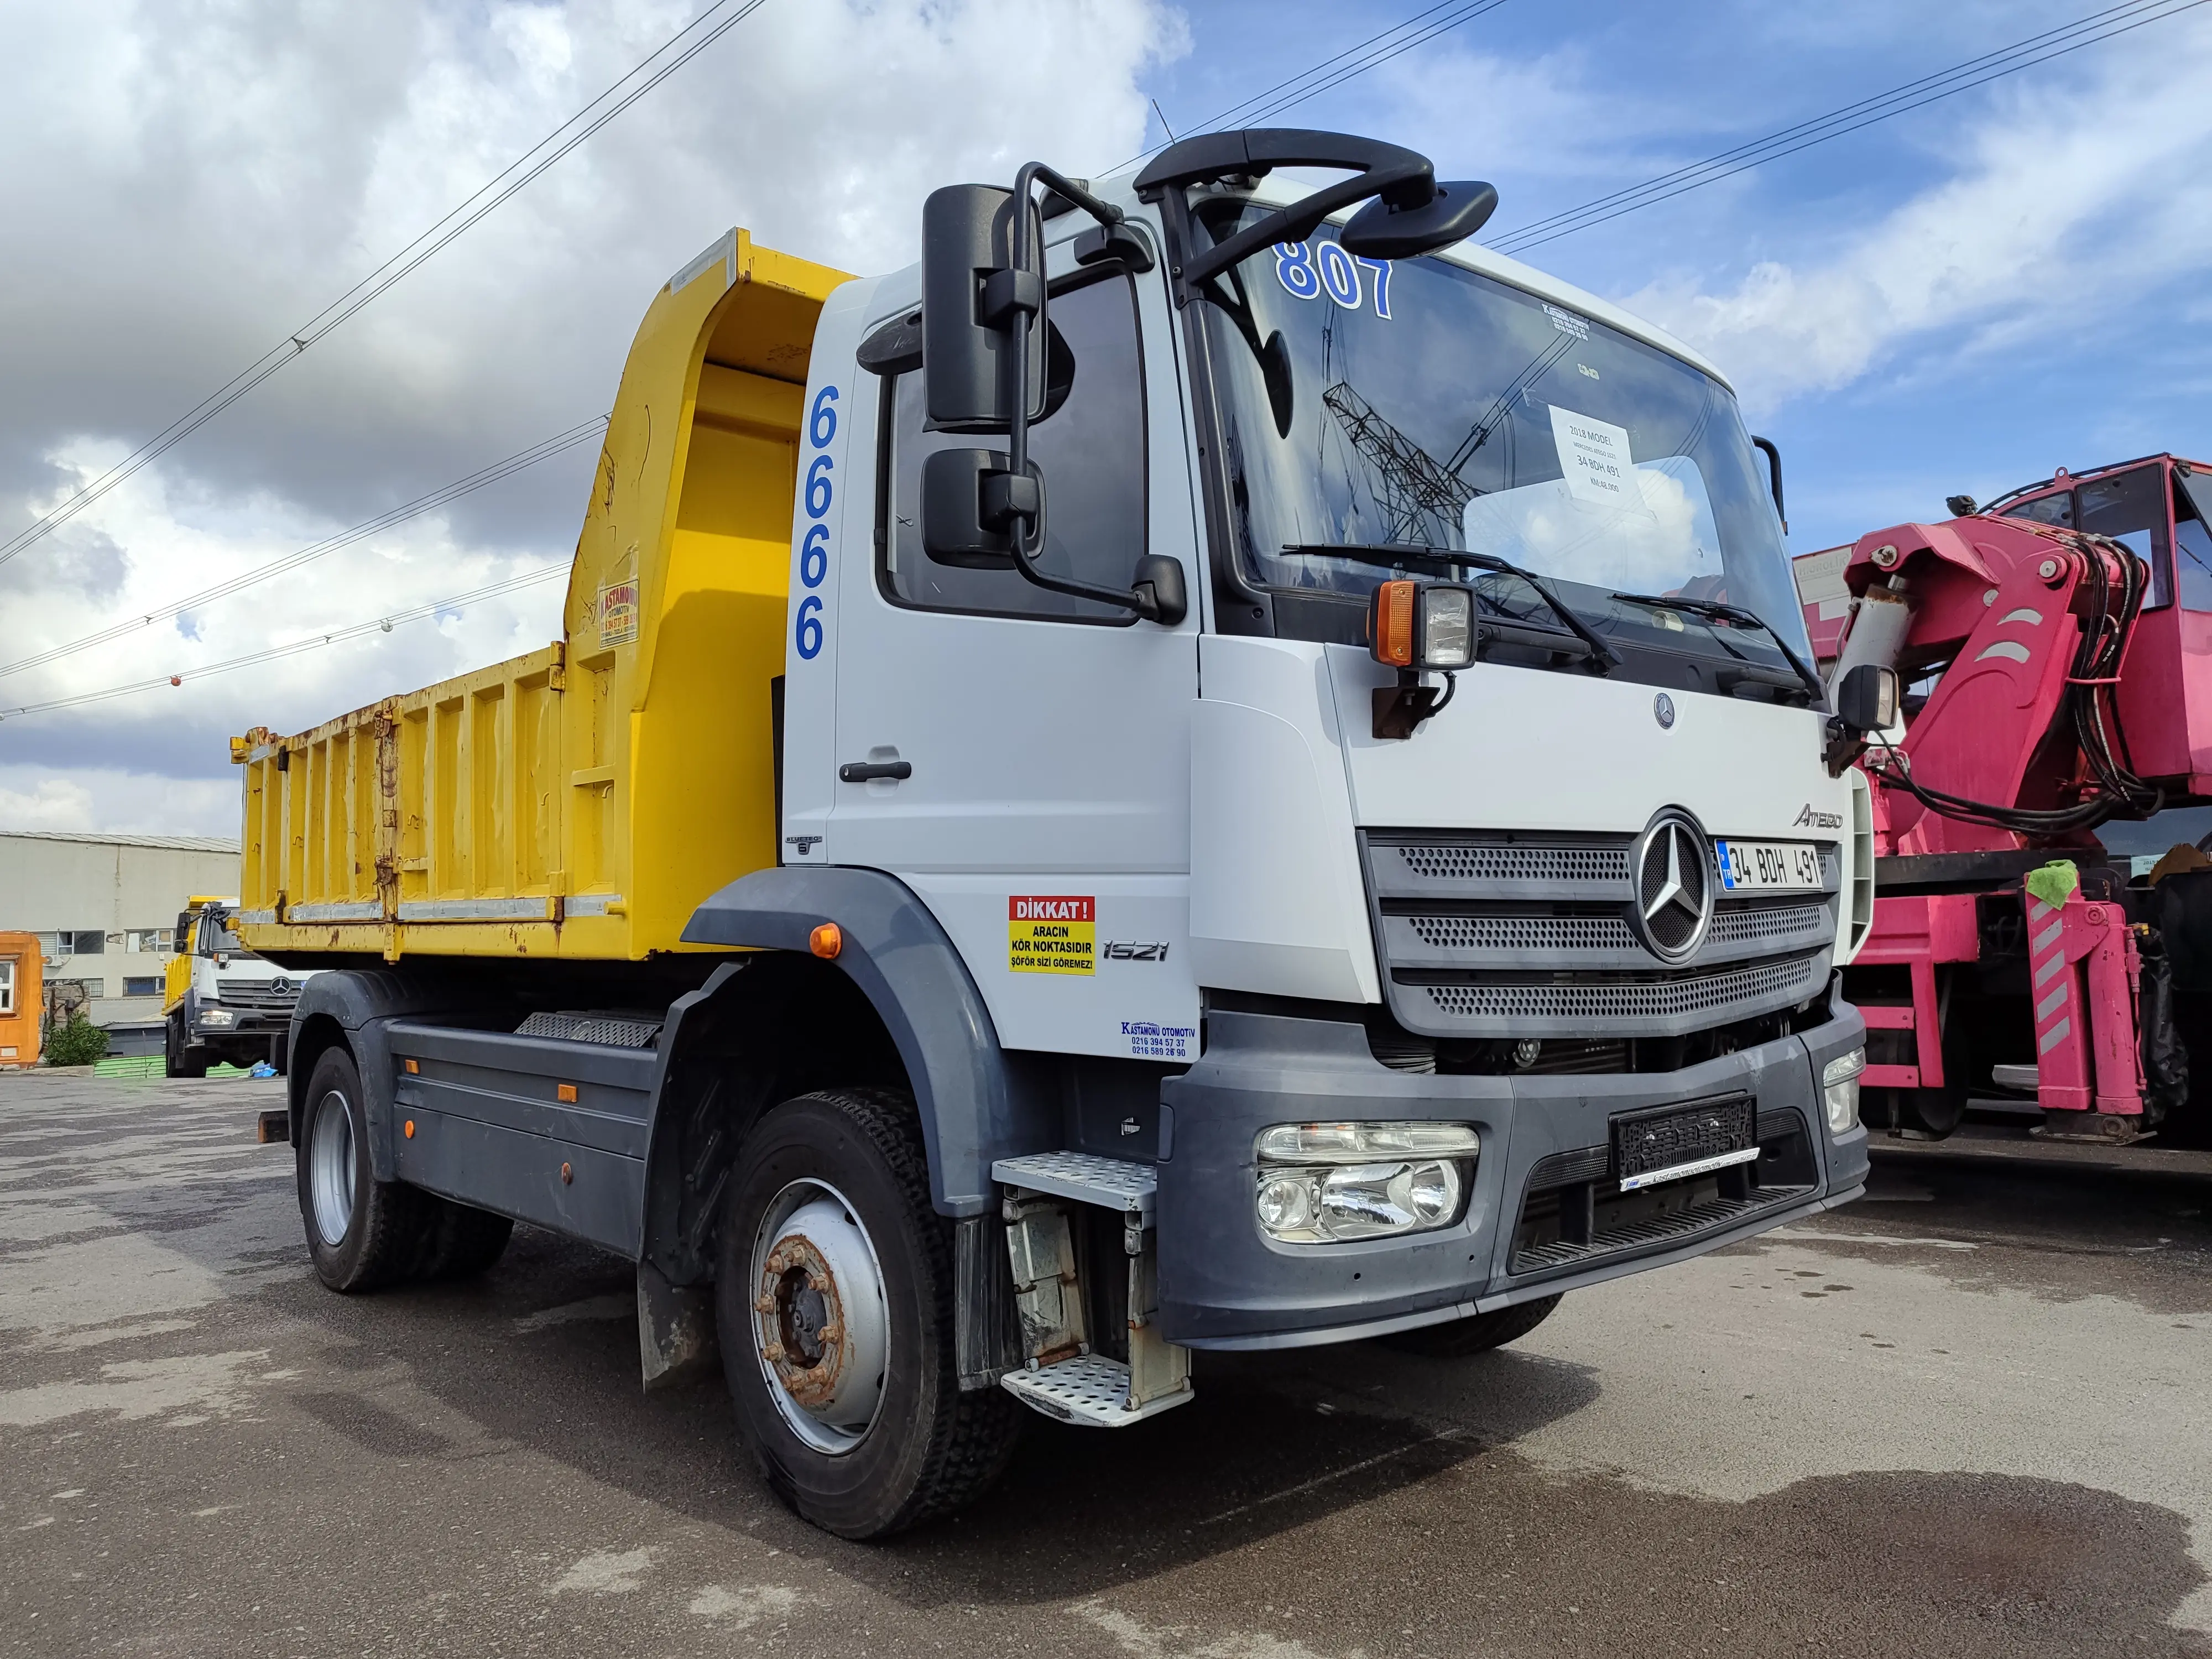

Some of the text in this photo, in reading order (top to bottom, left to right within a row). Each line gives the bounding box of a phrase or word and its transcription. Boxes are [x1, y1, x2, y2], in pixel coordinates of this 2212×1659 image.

[1271, 241, 1393, 321] 807
[1569, 425, 1613, 446] 2018 MODEL
[1594, 448, 1606, 457] ATEGO
[1577, 455, 1621, 478] 34 BDH 491
[1590, 477, 1619, 492] KM:48.000
[601, 586, 637, 619] KASTAMONU
[1792, 803, 1843, 828] ATEGO
[798, 843, 807, 852] 6
[1723, 847, 1819, 884] TR 34 BDH 491
[1033, 926, 1068, 937] ARACIN
[1012, 938, 1092, 954] KÖR NOKTASIDIR
[1103, 940, 1170, 962] 1521
[1011, 956, 1093, 969] ŞÖFÖR SİZİ GÖREMEZ!
[1121, 1022, 1195, 1037] KASTAMONU OTOMOTİV
[1132, 1046, 1186, 1057] 0216 589 26 90
